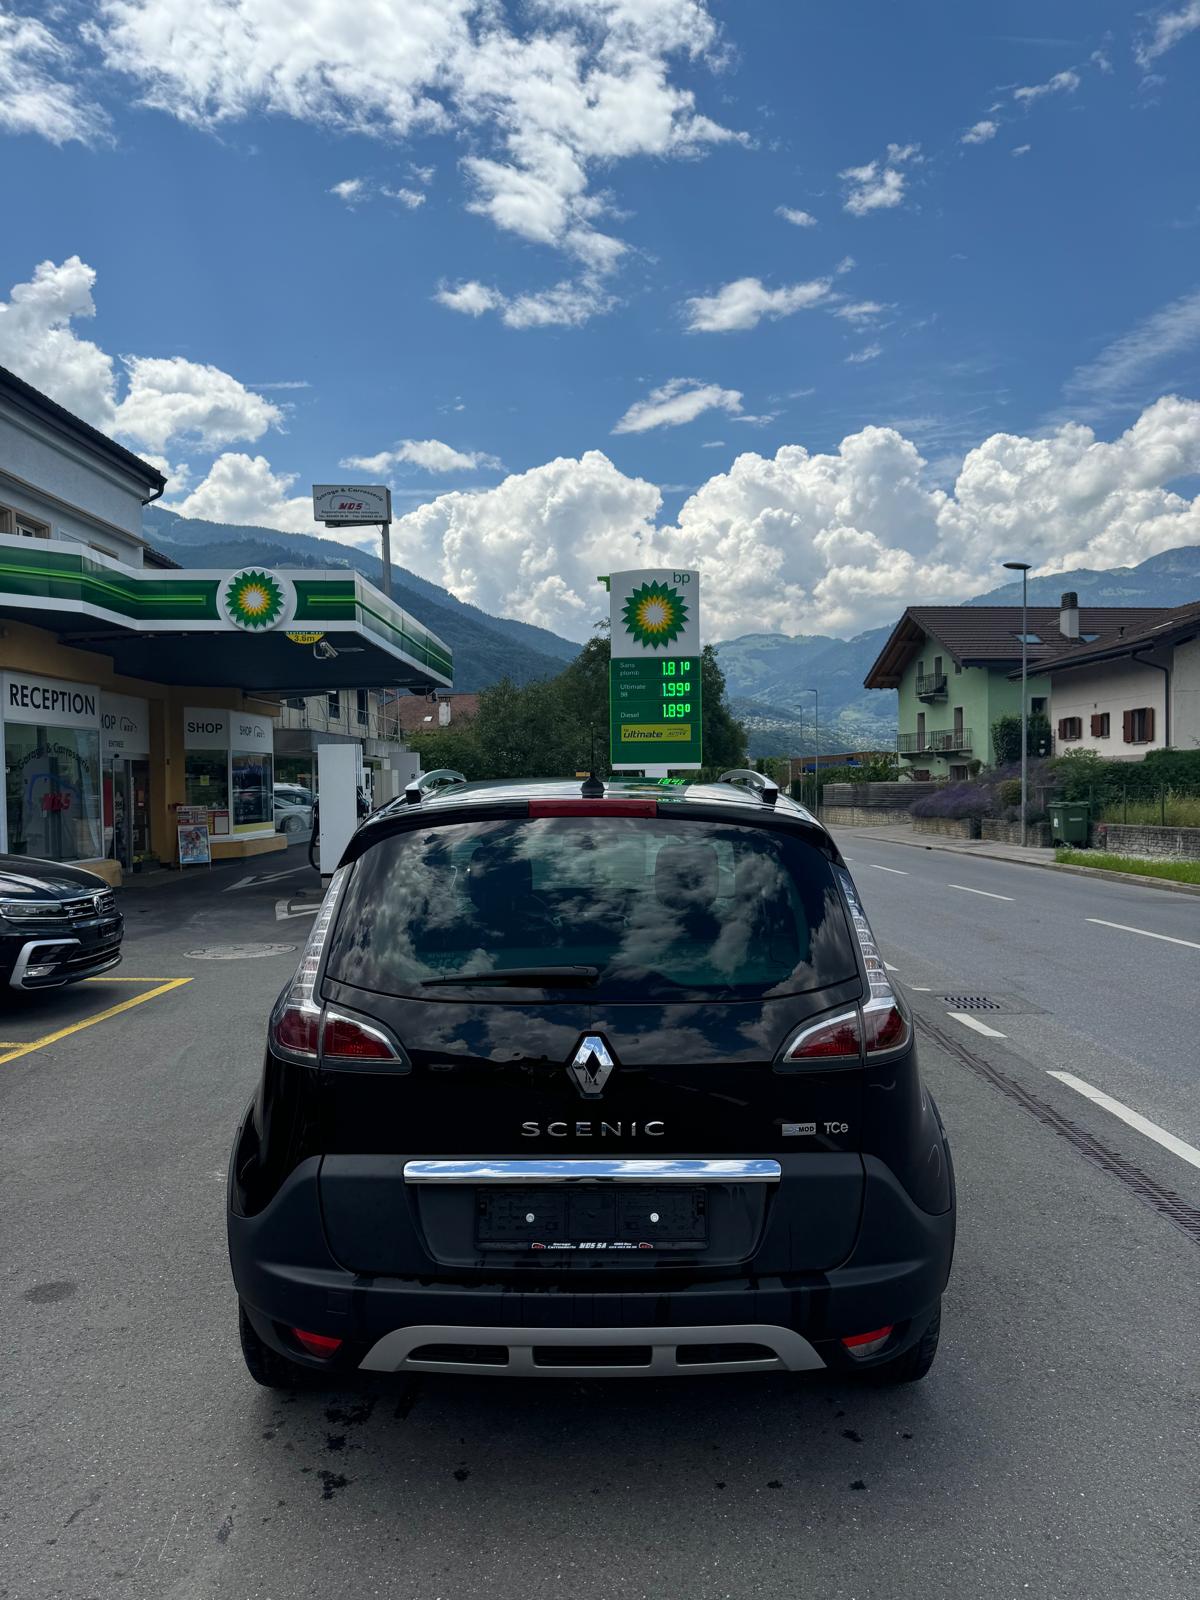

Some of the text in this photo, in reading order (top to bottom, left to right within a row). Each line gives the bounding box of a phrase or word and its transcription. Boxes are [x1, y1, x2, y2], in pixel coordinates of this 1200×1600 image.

[673, 571, 690, 586] bp
[9, 683, 96, 716] RECEPTION
[101, 713, 117, 729] HOP
[187, 721, 223, 734] SHOP
[521, 1121, 665, 1137] SCENIC
[823, 1121, 849, 1134] TCe
